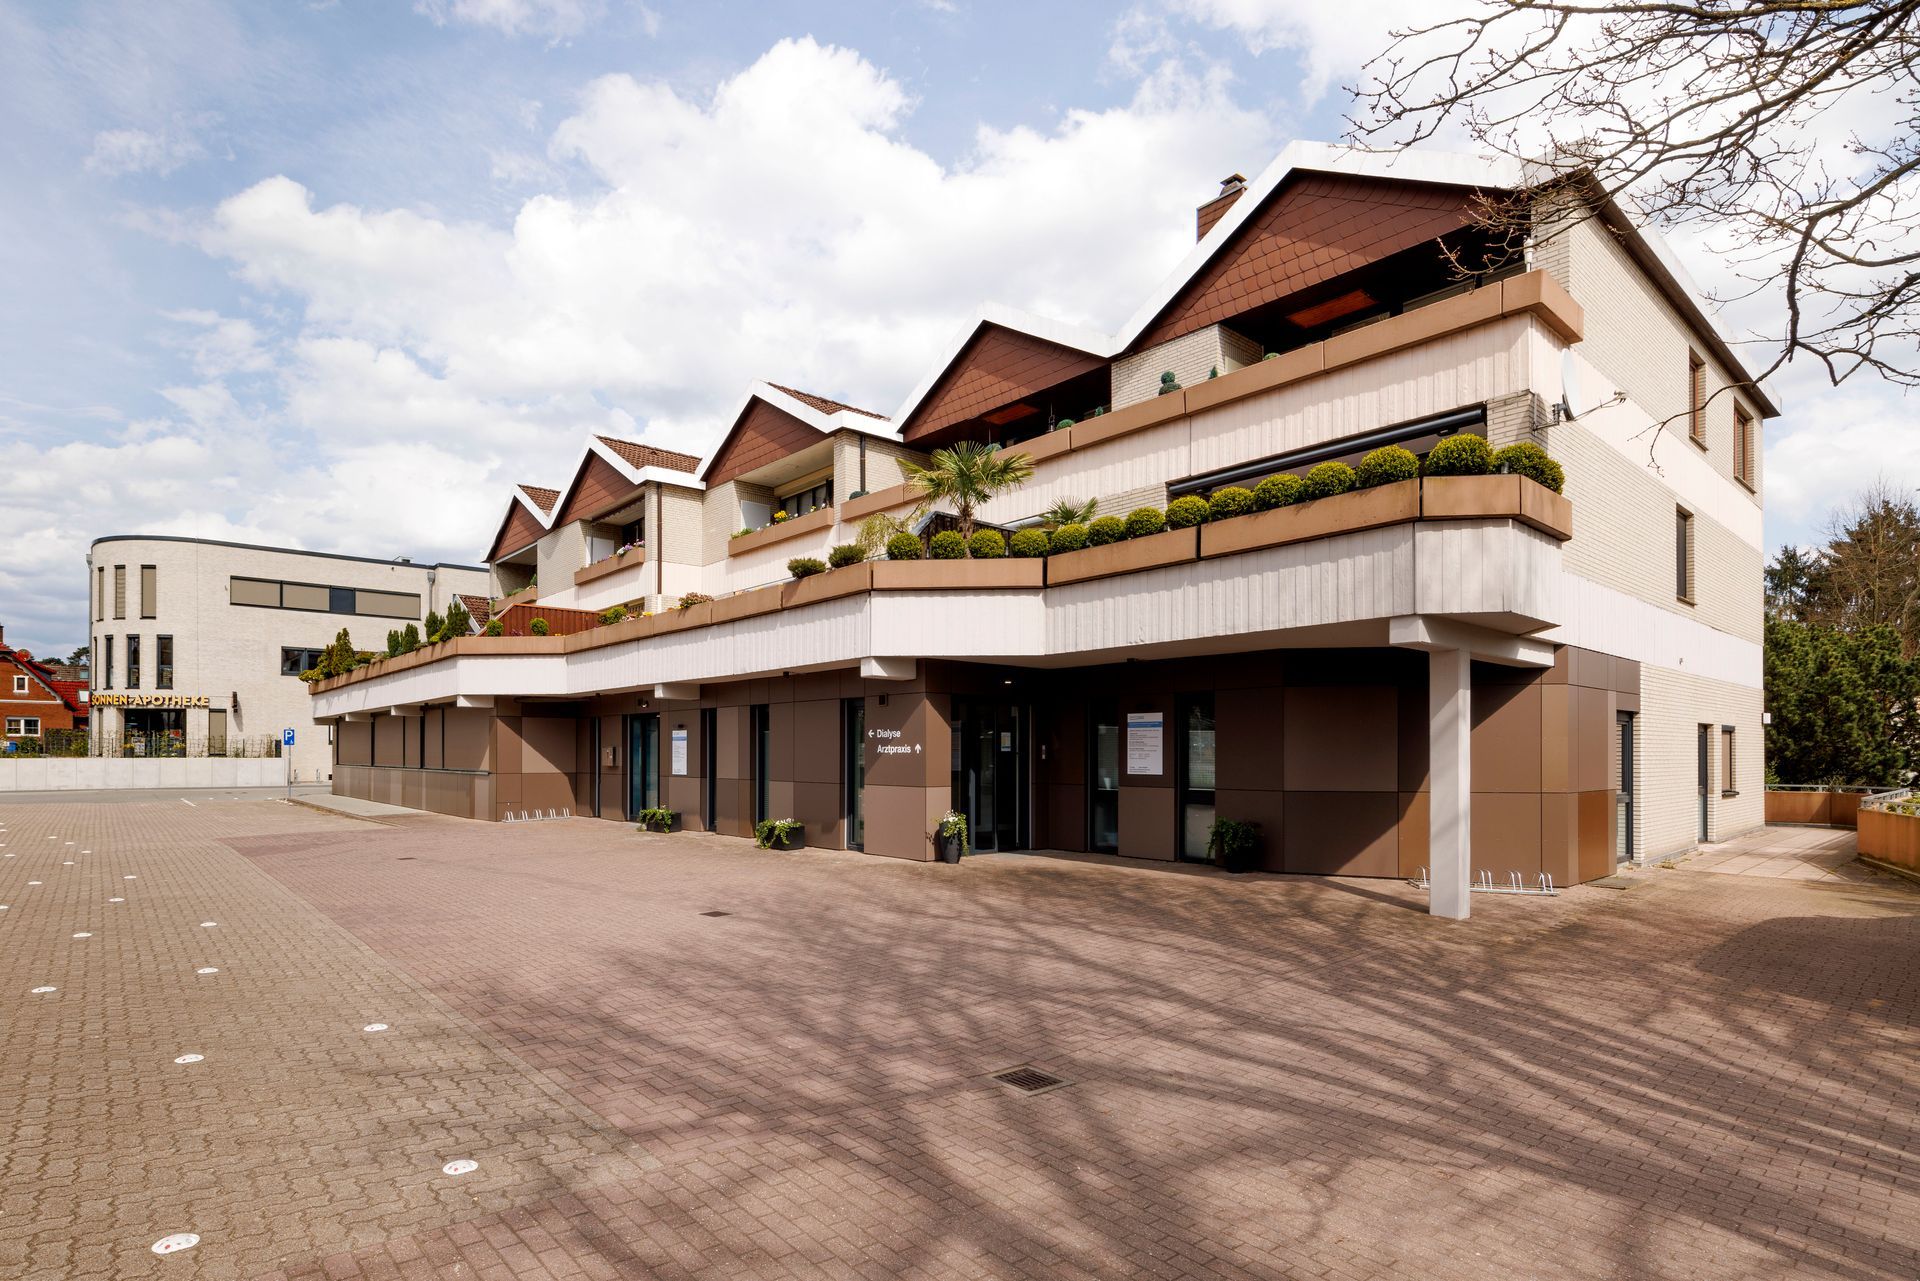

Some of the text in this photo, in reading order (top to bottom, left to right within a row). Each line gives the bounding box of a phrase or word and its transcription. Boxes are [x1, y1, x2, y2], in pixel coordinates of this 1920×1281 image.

[285, 730, 293, 741] P
[876, 729, 901, 739] Dialyse
[877, 744, 911, 755] Arztpraxis
